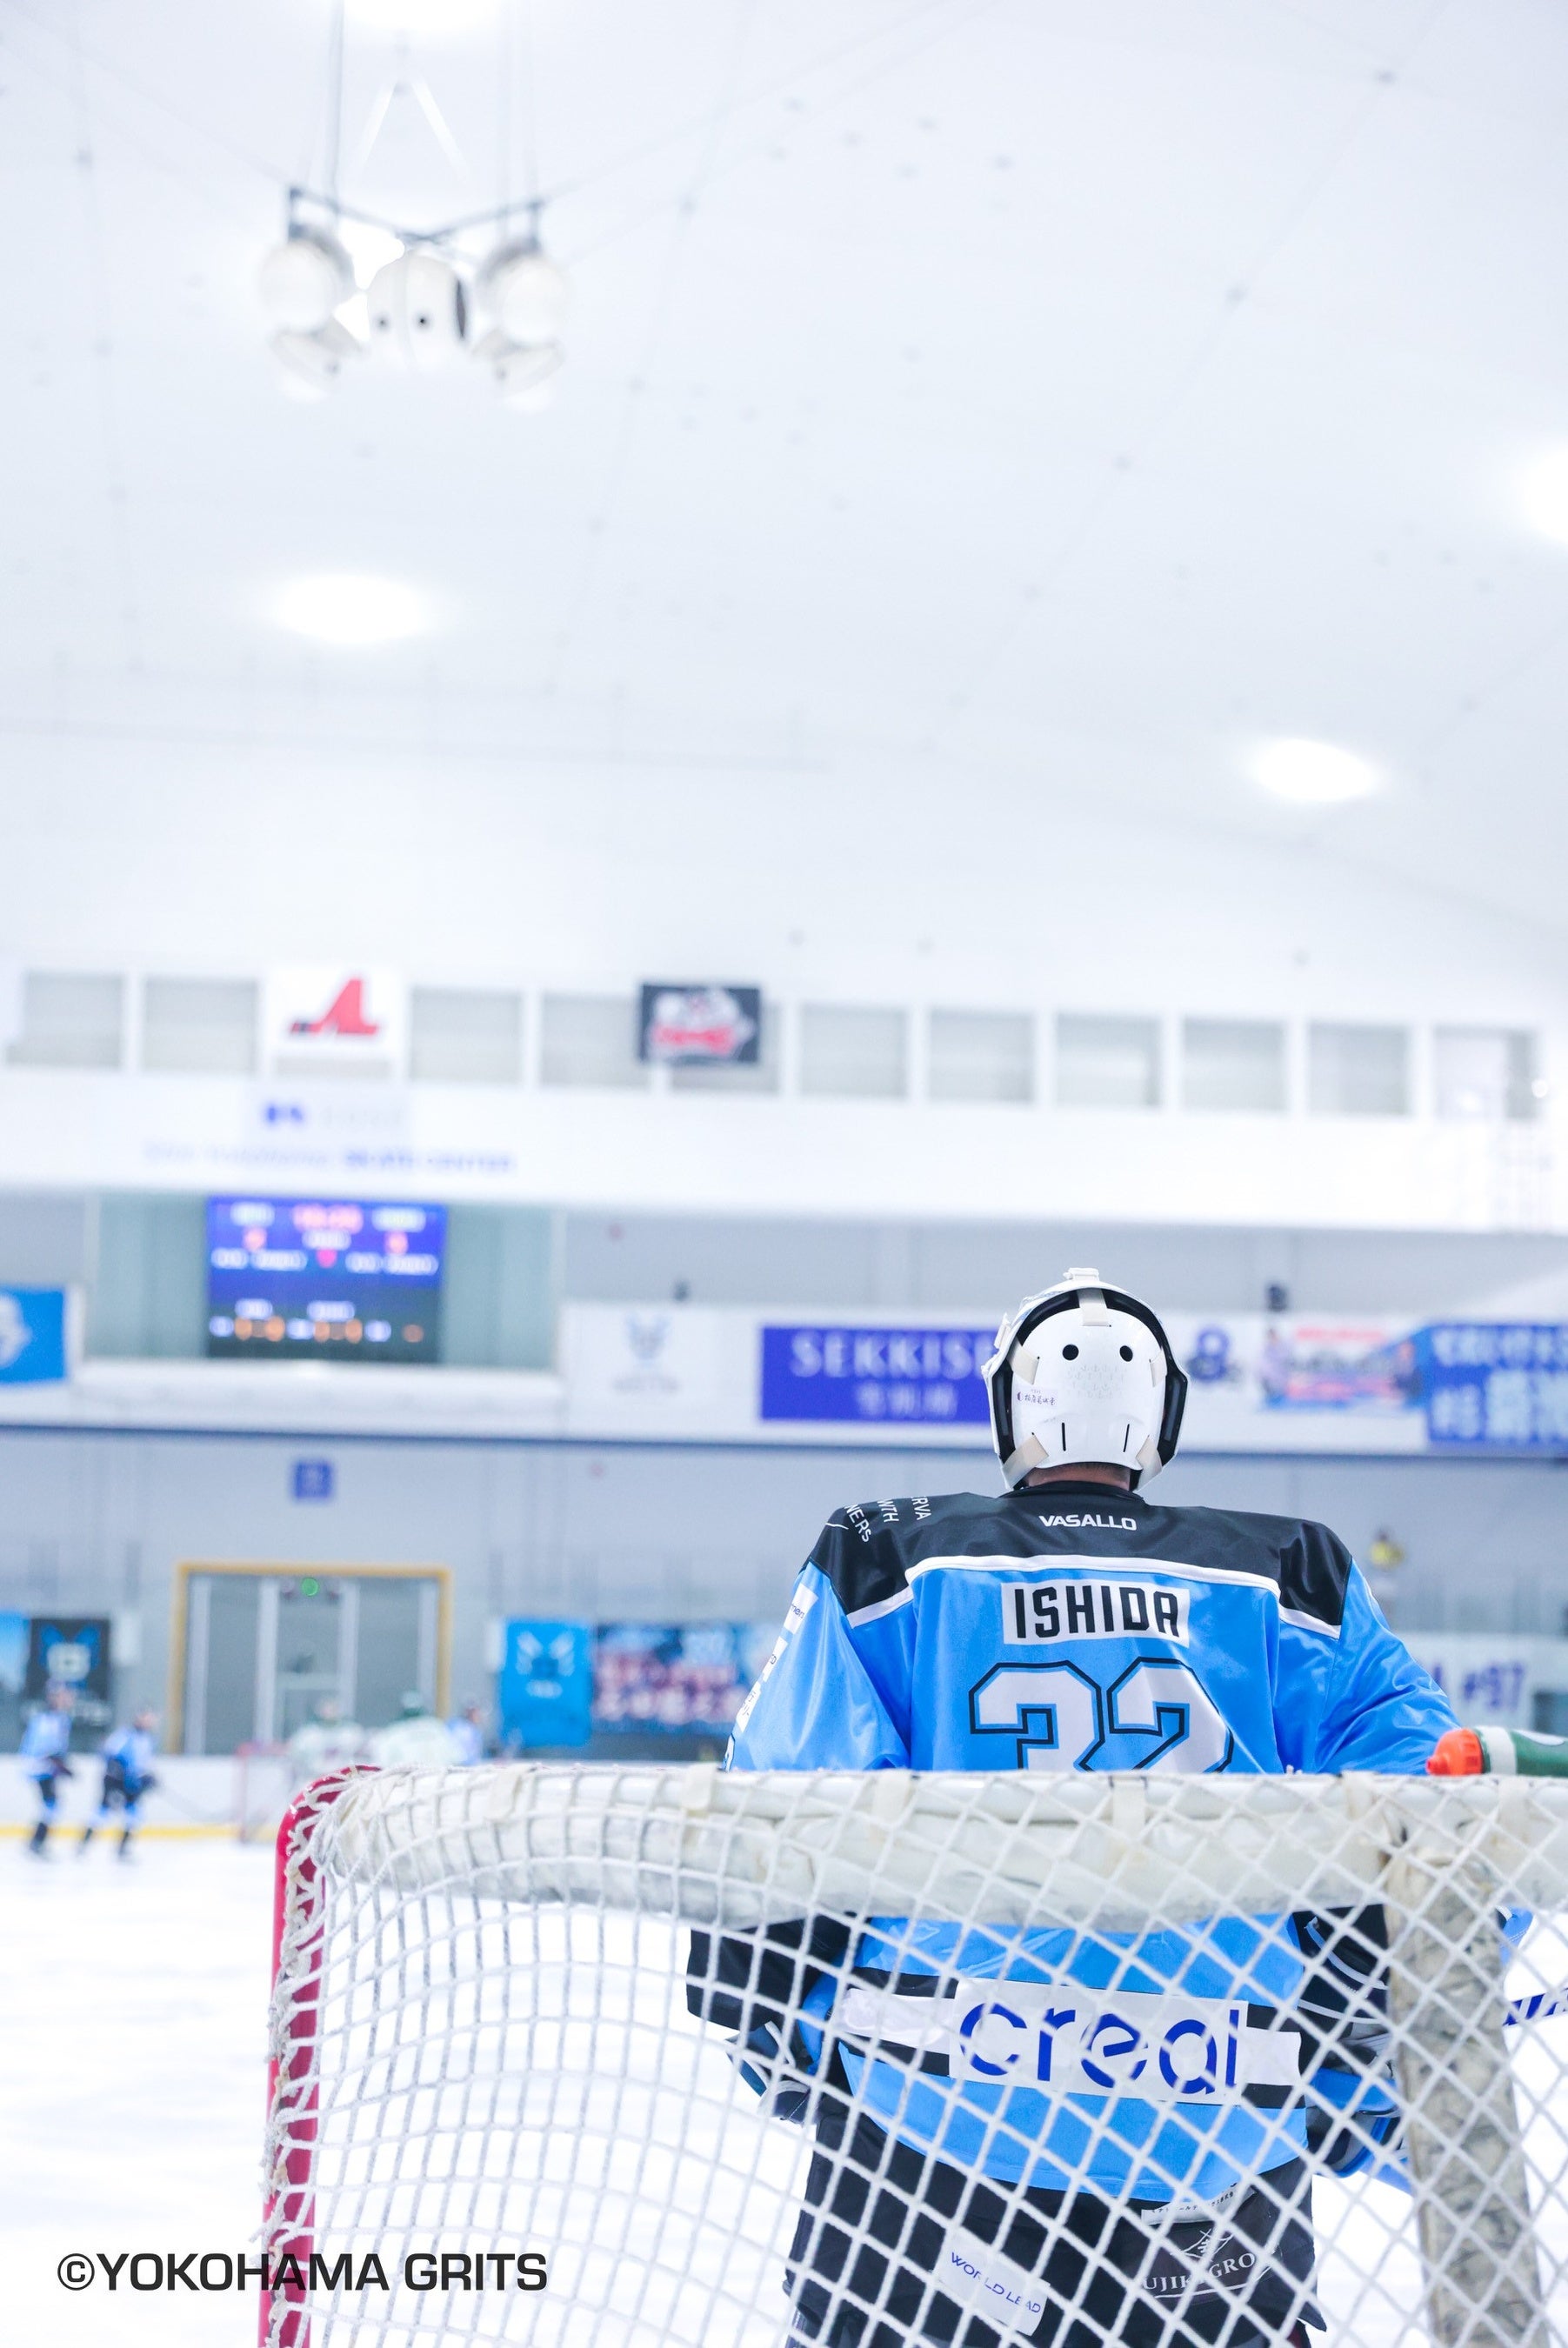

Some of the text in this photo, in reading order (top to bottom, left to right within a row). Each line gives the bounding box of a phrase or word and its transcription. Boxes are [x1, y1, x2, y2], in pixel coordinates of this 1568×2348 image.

[1038, 1513, 1138, 1531] VASALLO
[1014, 1584, 1180, 1639] ISHIDA
[959, 2002, 1240, 2096] creal
[1208, 2251, 1257, 2280] GRO
